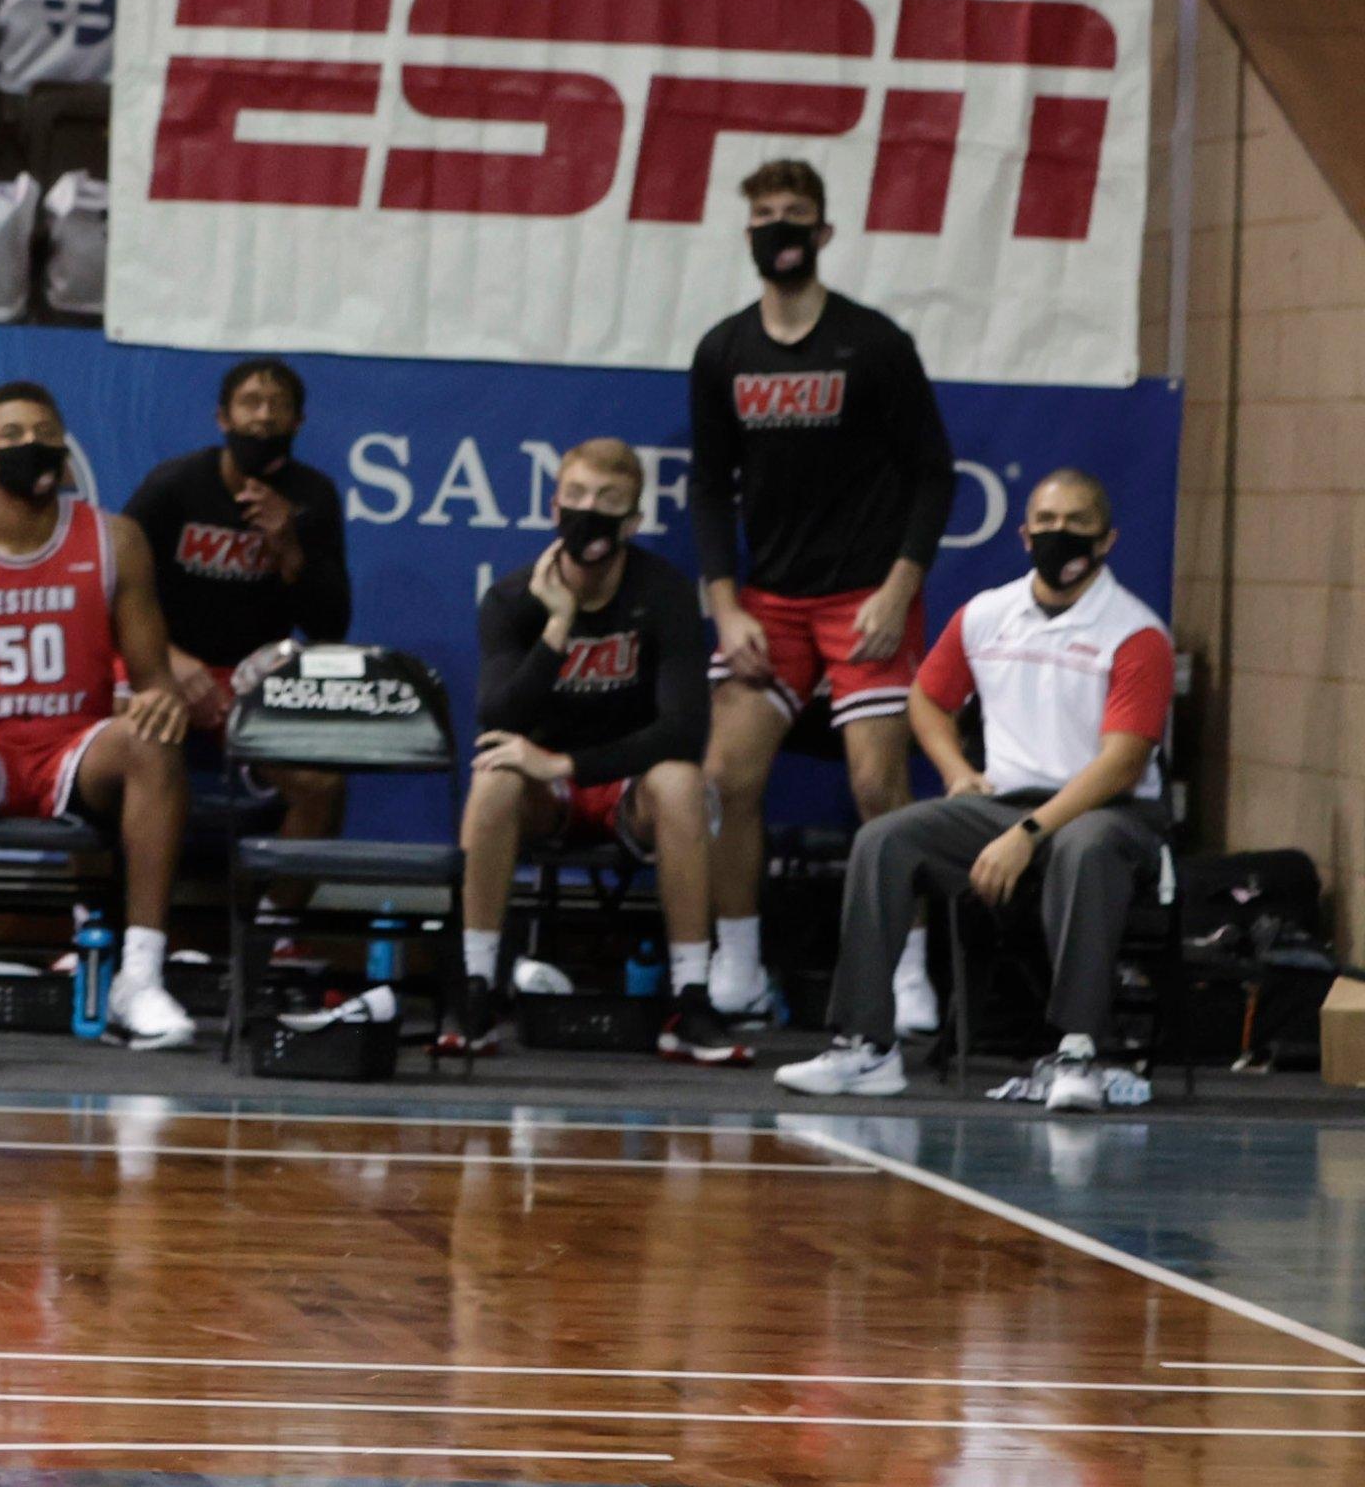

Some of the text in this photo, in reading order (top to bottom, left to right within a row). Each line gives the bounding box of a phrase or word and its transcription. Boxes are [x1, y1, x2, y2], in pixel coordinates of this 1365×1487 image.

[732, 369, 847, 421] WKU
[175, 522, 265, 572] WK
[263, 676, 318, 697] BAD
